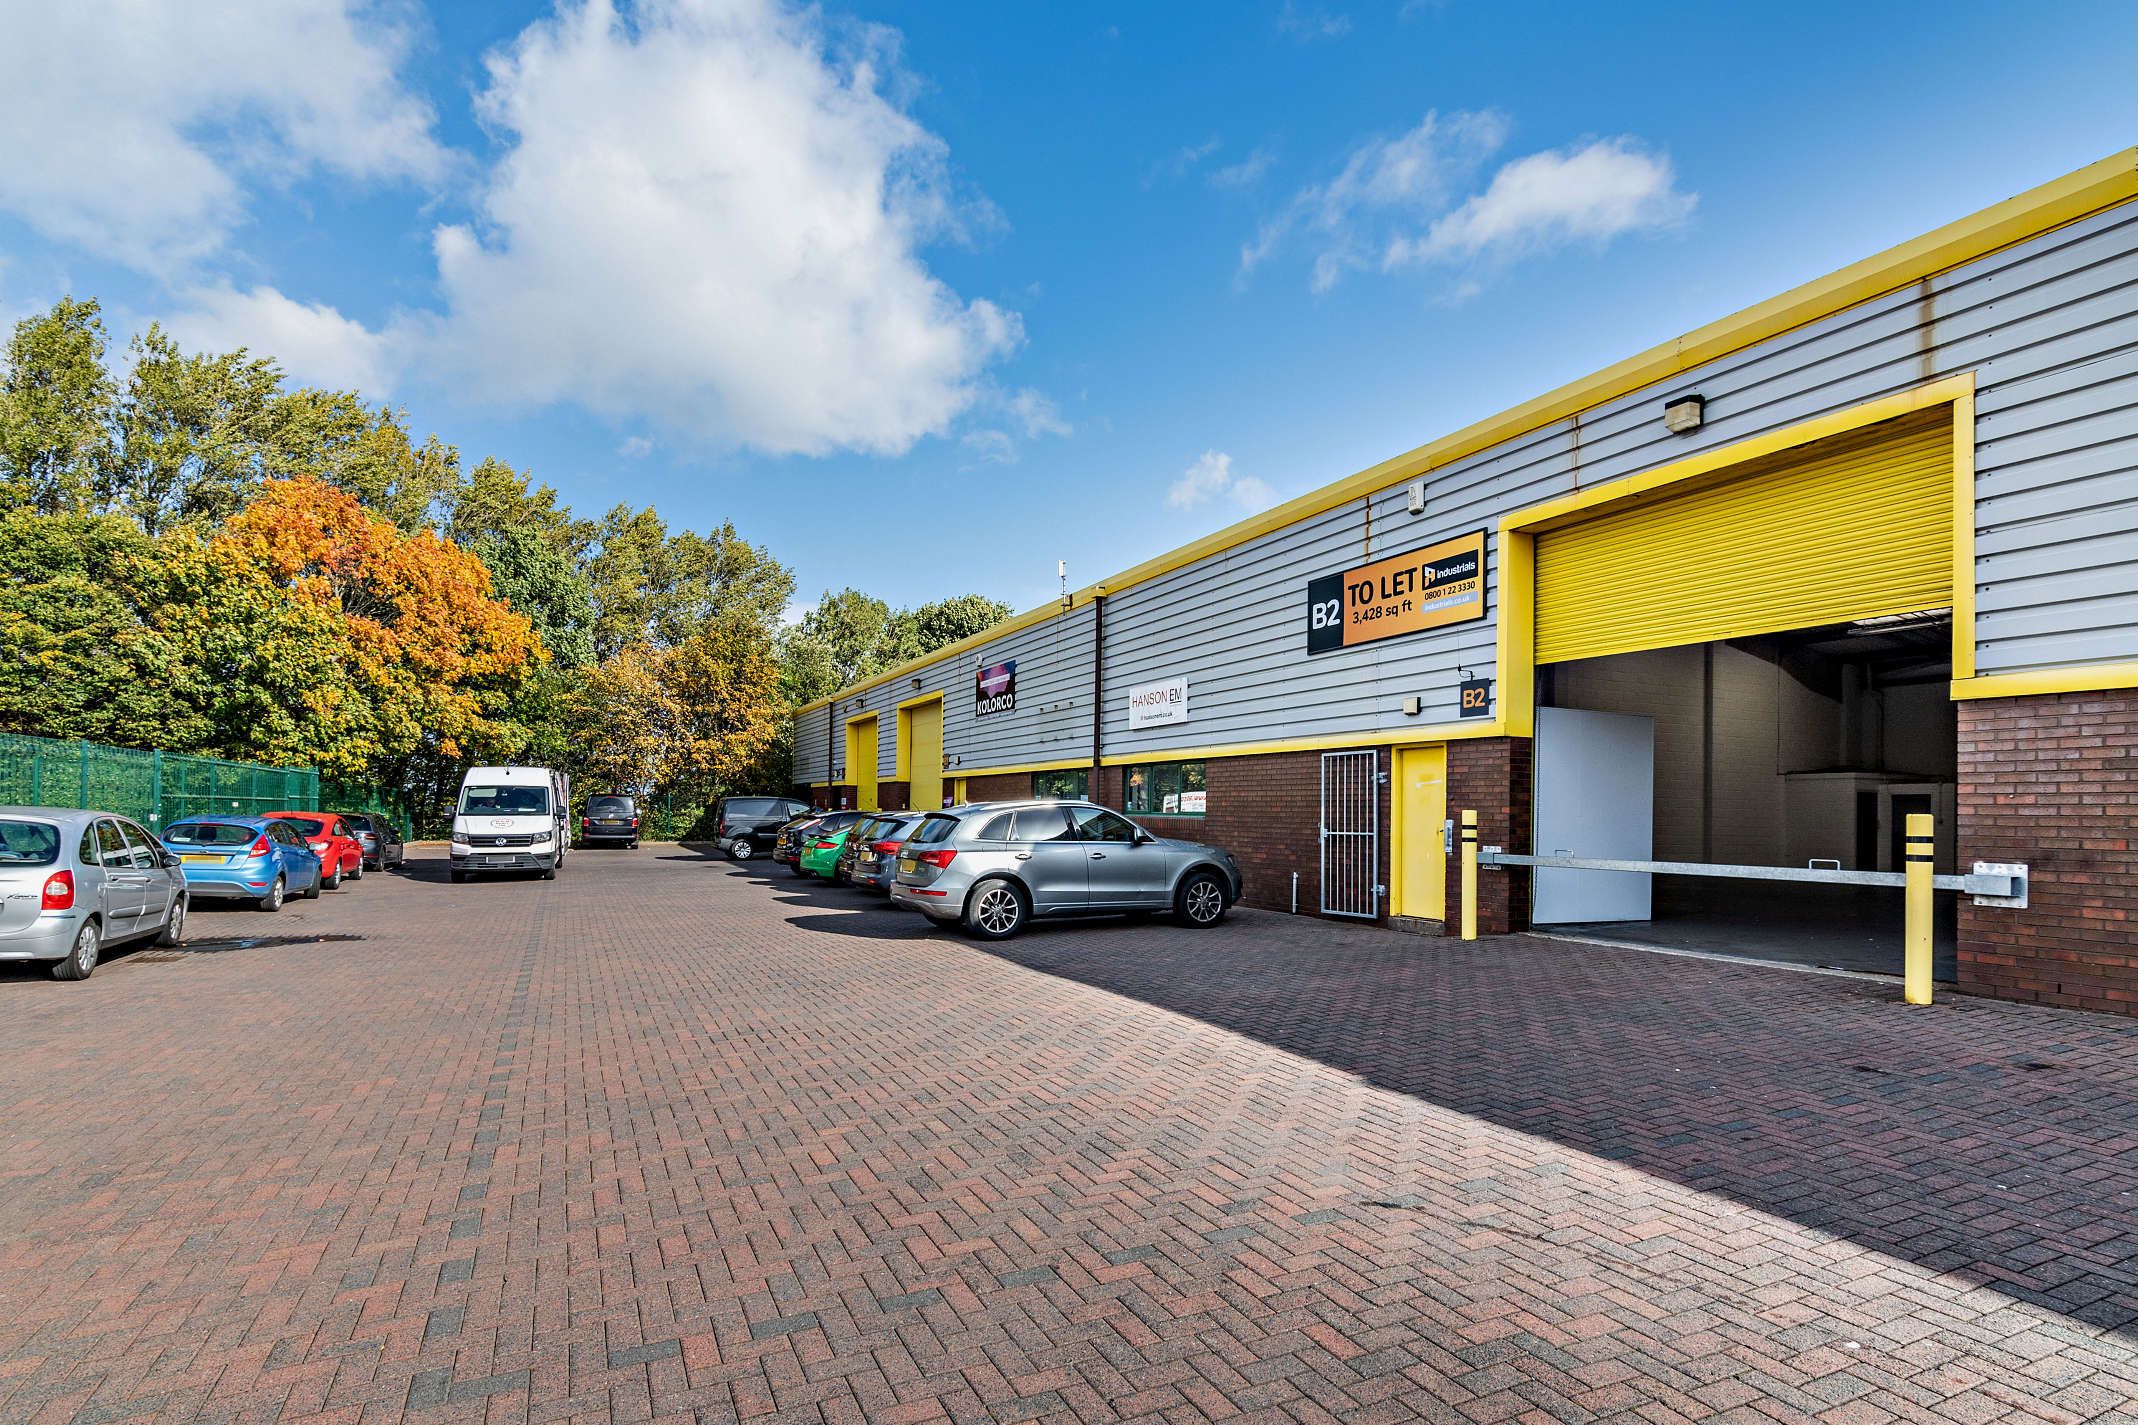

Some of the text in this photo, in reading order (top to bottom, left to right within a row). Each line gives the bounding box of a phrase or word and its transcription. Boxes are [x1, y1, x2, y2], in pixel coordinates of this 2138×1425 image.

[1437, 561, 1476, 579] industrials
[1348, 567, 1418, 607] TO LET
[1424, 589, 1442, 601] 0800
[1447, 586, 1457, 595] 22
[1457, 580, 1476, 593] 3330
[1312, 599, 1341, 630] B2
[1352, 599, 1413, 625] 3,428 sq ft
[977, 693, 1013, 715] KOLORCO
[1132, 689, 1168, 708] HANSON
[1463, 687, 1486, 709] B2
